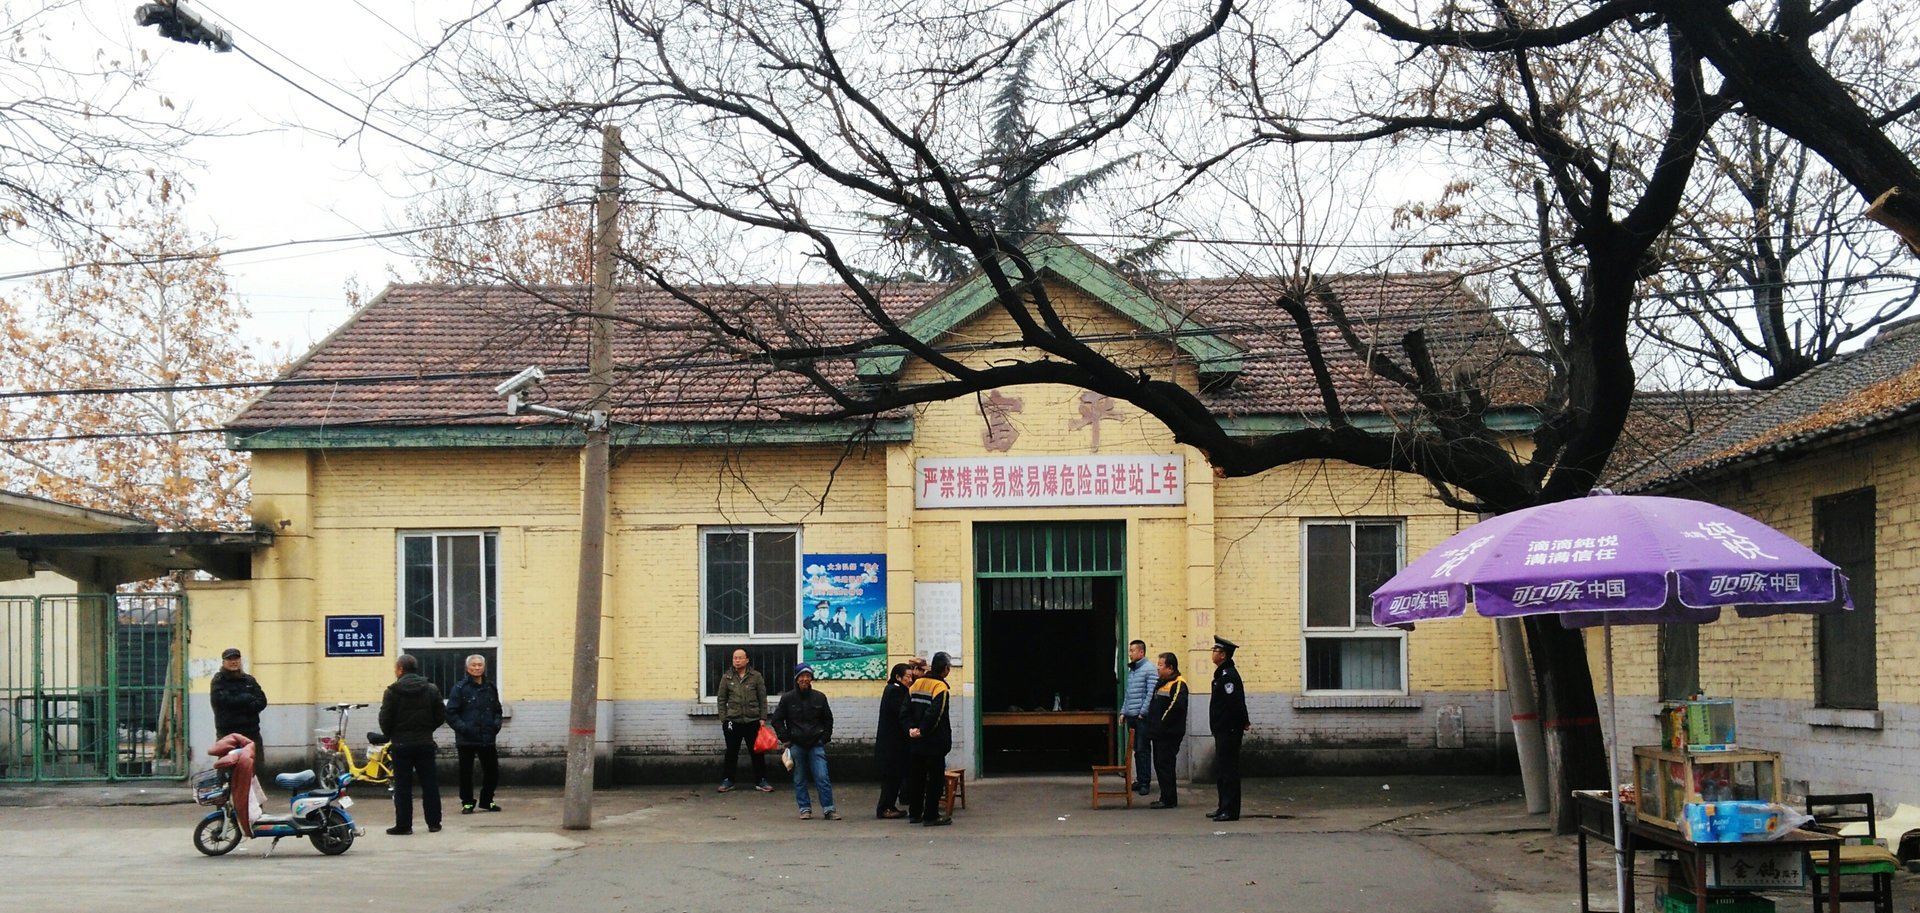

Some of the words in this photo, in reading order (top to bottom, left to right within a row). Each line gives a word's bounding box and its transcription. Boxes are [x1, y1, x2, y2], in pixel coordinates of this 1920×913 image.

[922, 463, 1178, 498] 严禁携带易燃易爆危险品进站上车
[1527, 534, 1619, 552] 滴滴纯悦
[1524, 548, 1618, 566] 满满信任
